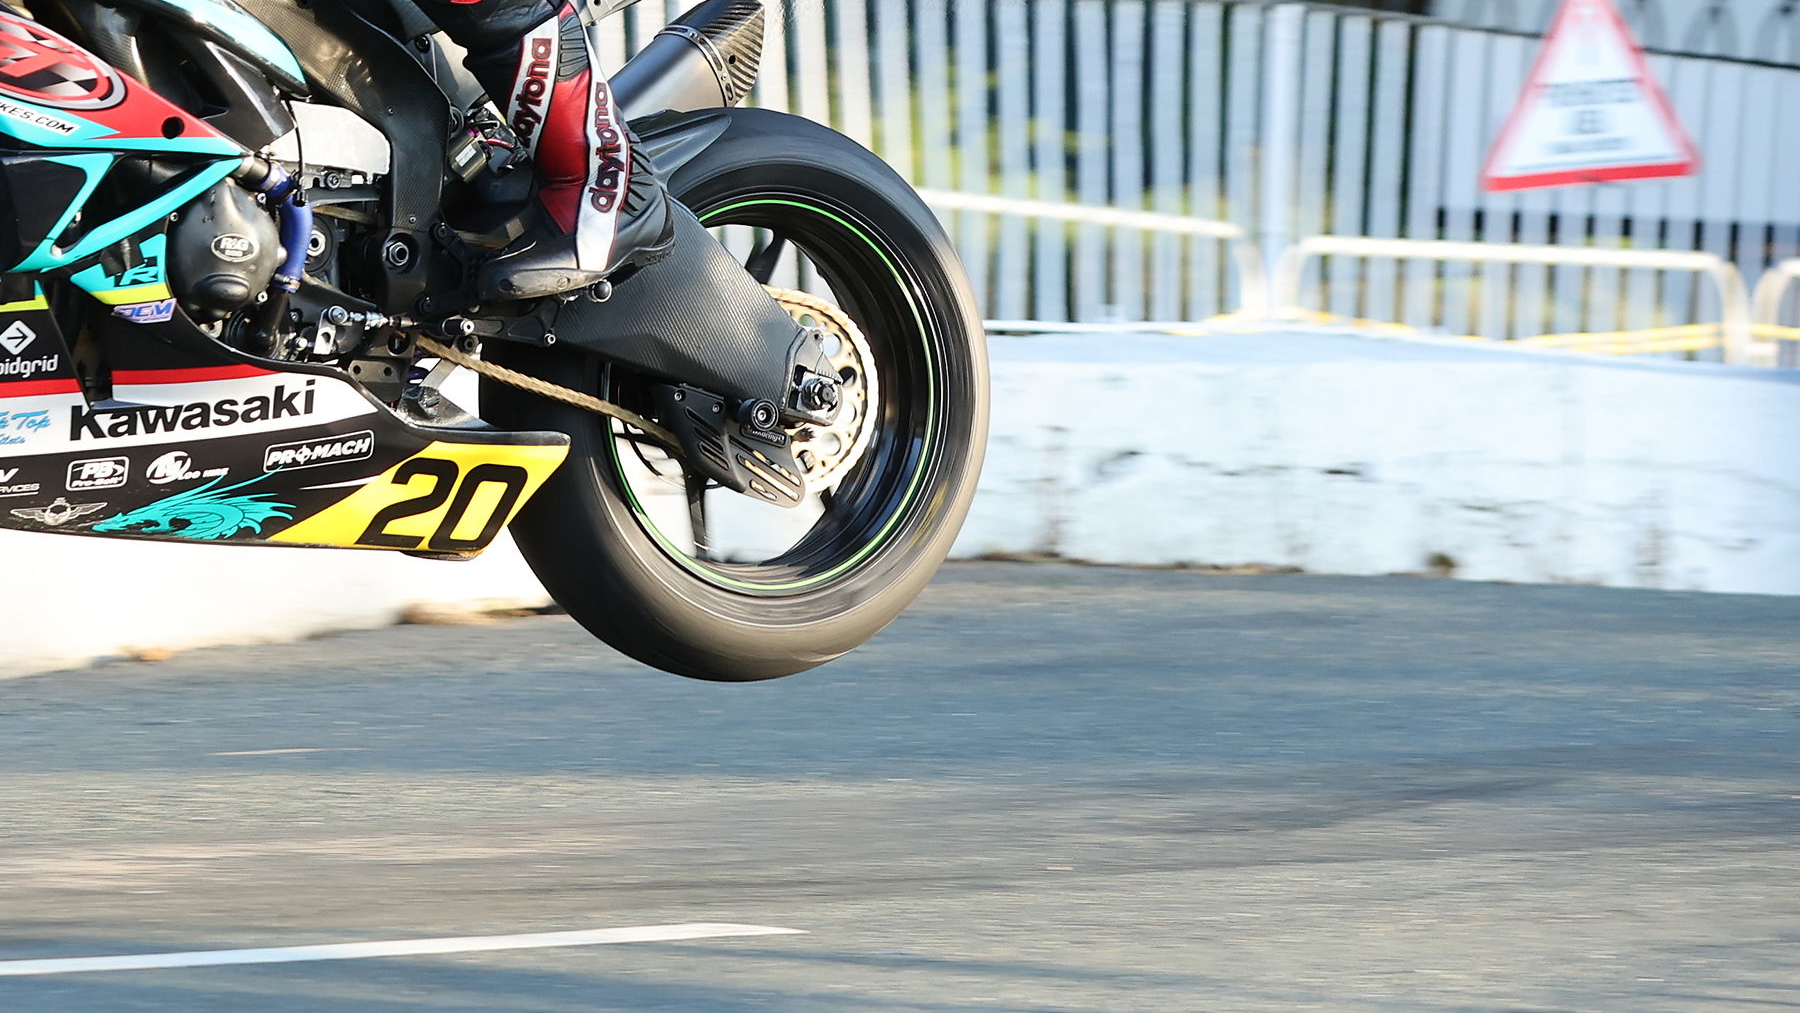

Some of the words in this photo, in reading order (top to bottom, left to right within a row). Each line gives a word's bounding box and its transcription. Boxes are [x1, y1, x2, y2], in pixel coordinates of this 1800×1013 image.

[588, 82, 625, 214] daytona
[11, 409, 51, 433] Top
[70, 379, 316, 442] Kawasaki
[354, 456, 530, 550] 20
